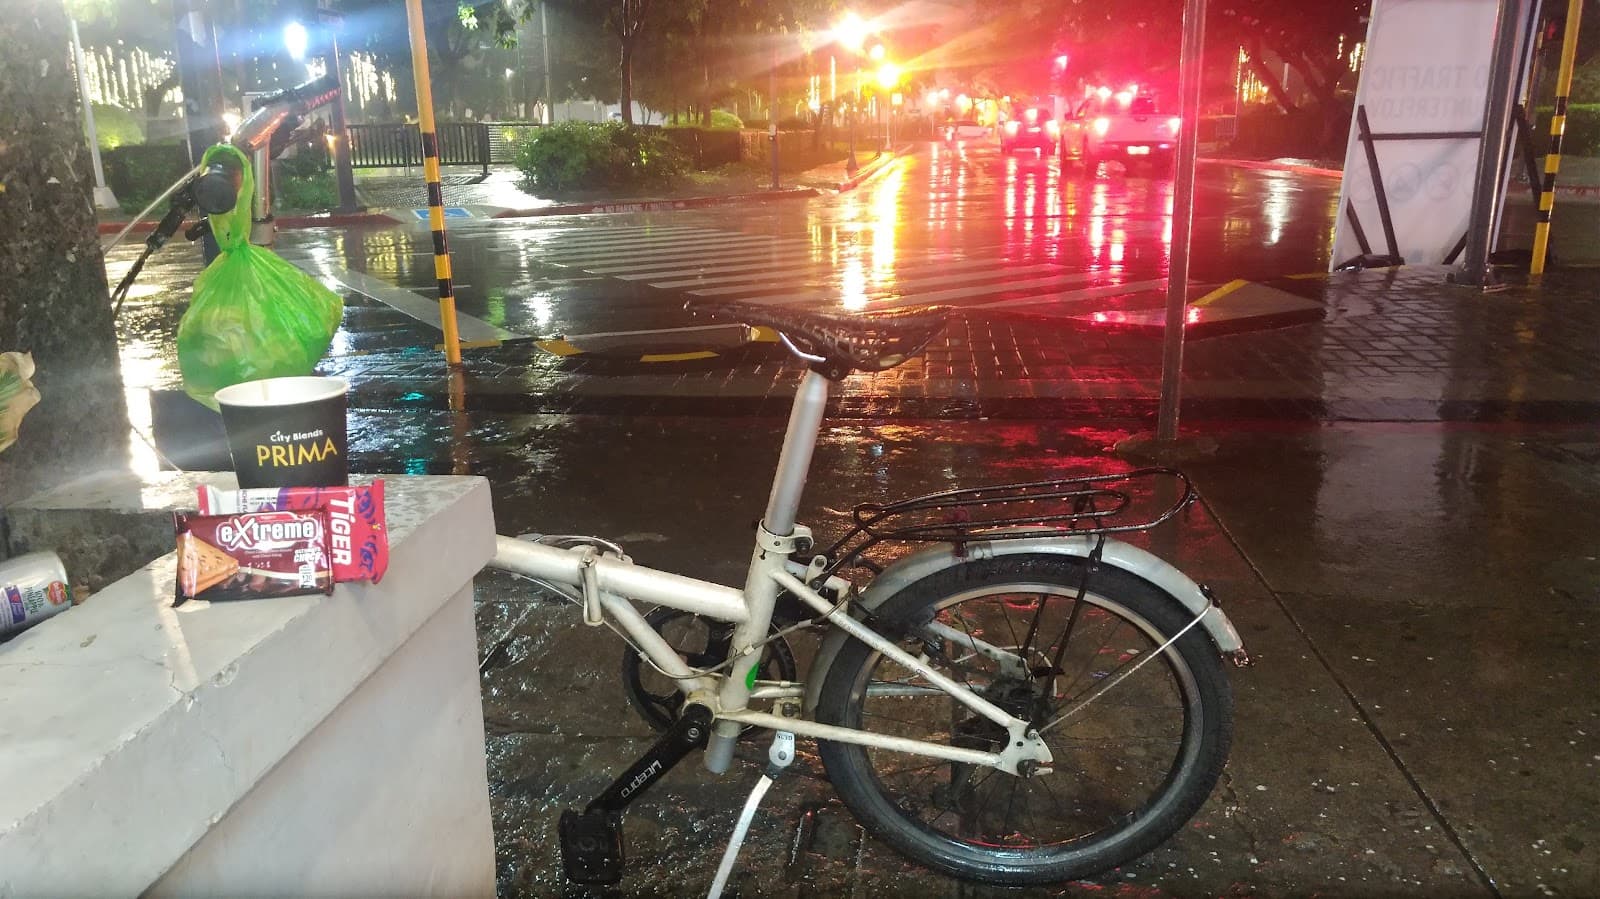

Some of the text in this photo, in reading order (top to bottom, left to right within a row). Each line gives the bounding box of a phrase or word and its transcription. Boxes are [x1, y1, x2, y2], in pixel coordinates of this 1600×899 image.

[270, 429, 323, 443] City Blends
[256, 437, 338, 467] PRIMA
[221, 517, 314, 547] eXtreme
